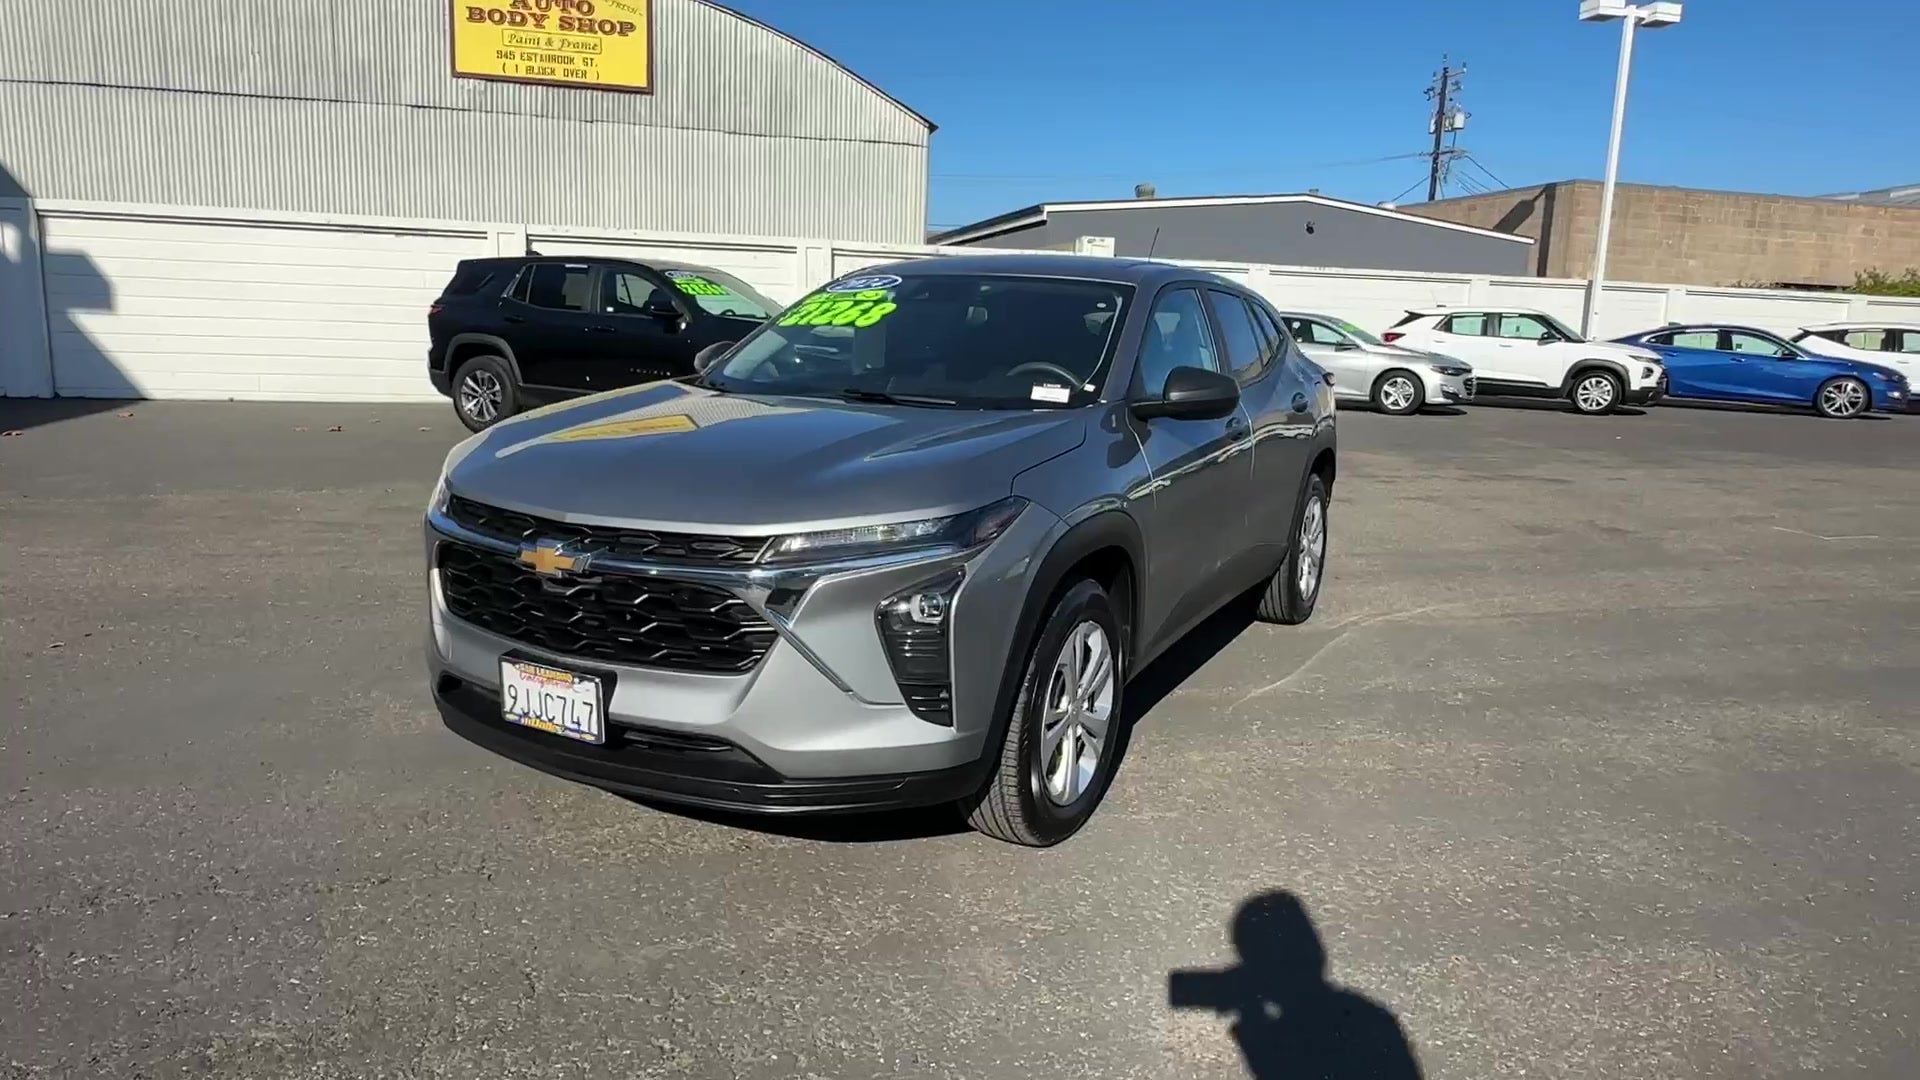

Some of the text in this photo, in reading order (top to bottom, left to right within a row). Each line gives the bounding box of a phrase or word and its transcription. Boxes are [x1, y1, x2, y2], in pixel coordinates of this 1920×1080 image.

[509, 0, 596, 17] AUTO
[466, 6, 637, 37] BODY SHOP
[508, 34, 540, 47] Paint
[558, 38, 598, 52] Frame
[496, 50, 516, 60] 945
[563, 69, 588, 80] OVER
[508, 684, 593, 732] 9JJC747
